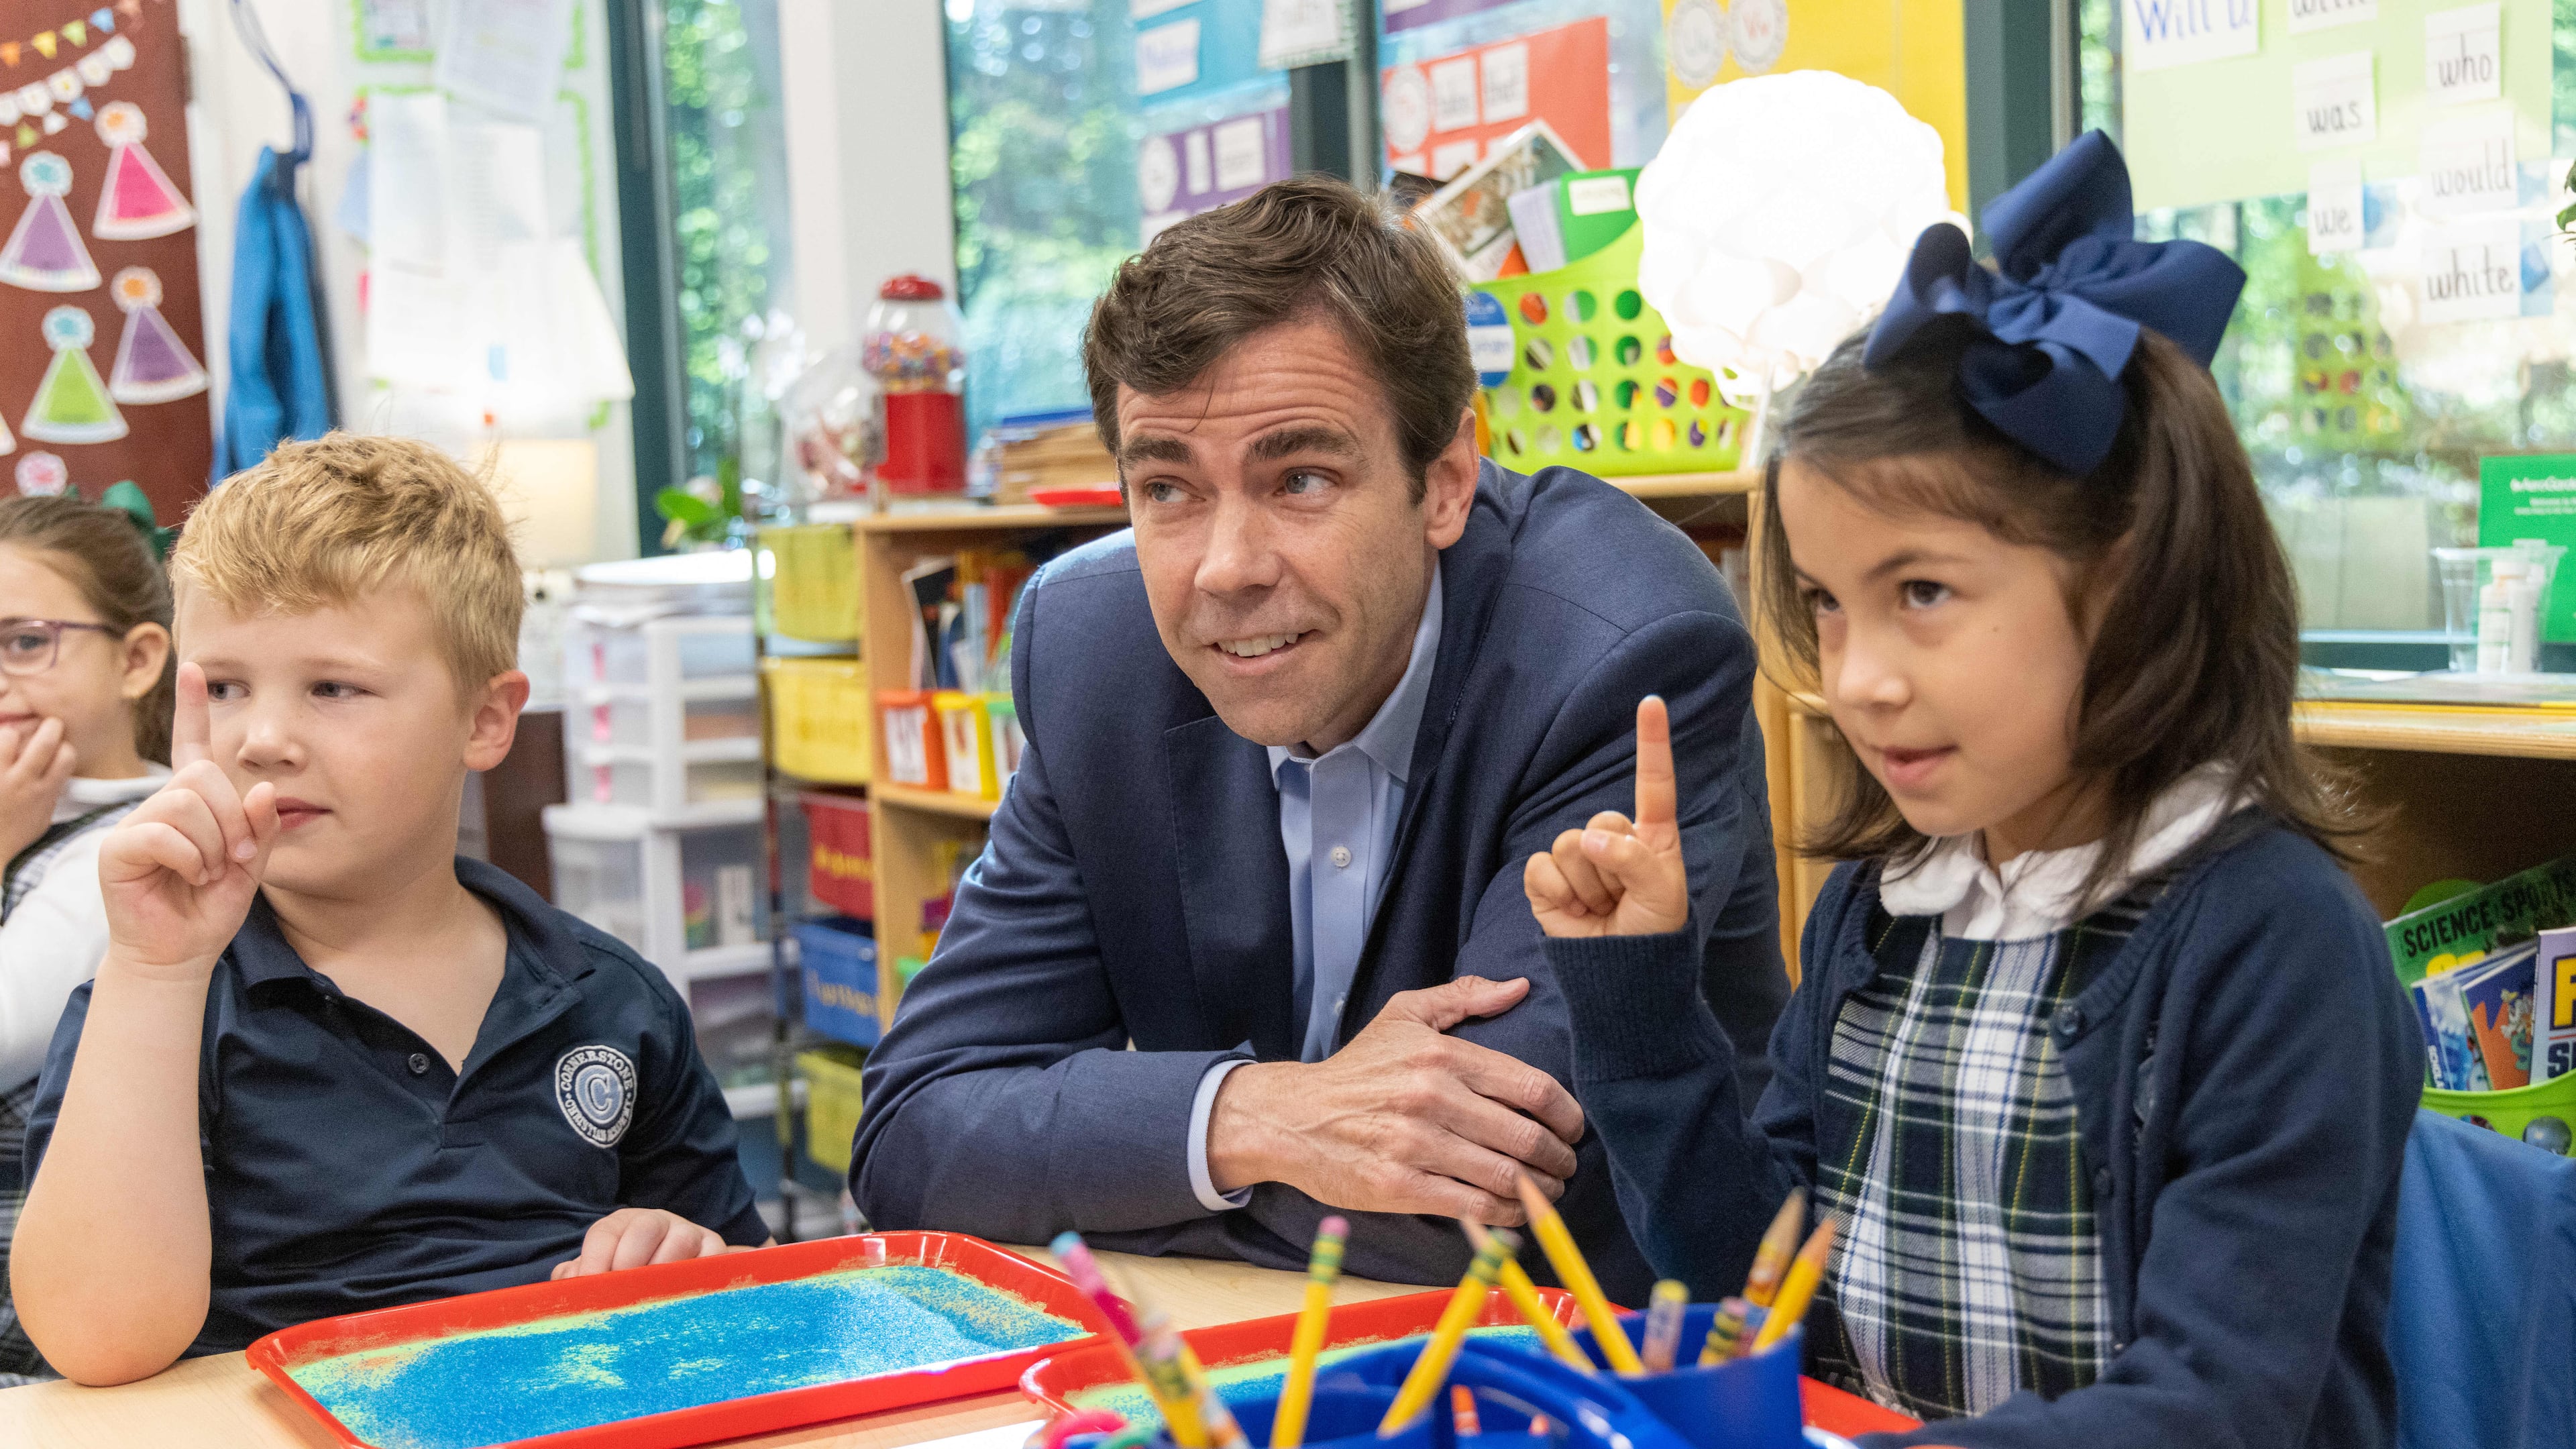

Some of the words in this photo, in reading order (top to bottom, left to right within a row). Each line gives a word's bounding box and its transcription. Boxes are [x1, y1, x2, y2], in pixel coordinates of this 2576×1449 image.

[2438, 33, 2493, 88] who
[2306, 101, 2362, 133] was
[2430, 138, 2512, 197] would
[2314, 209, 2353, 235] we
[2426, 245, 2514, 300] white
[2403, 900, 2494, 958] SCIENCE
[561, 1051, 633, 1090] CORNERSTONE
[584, 1073, 612, 1115] C
